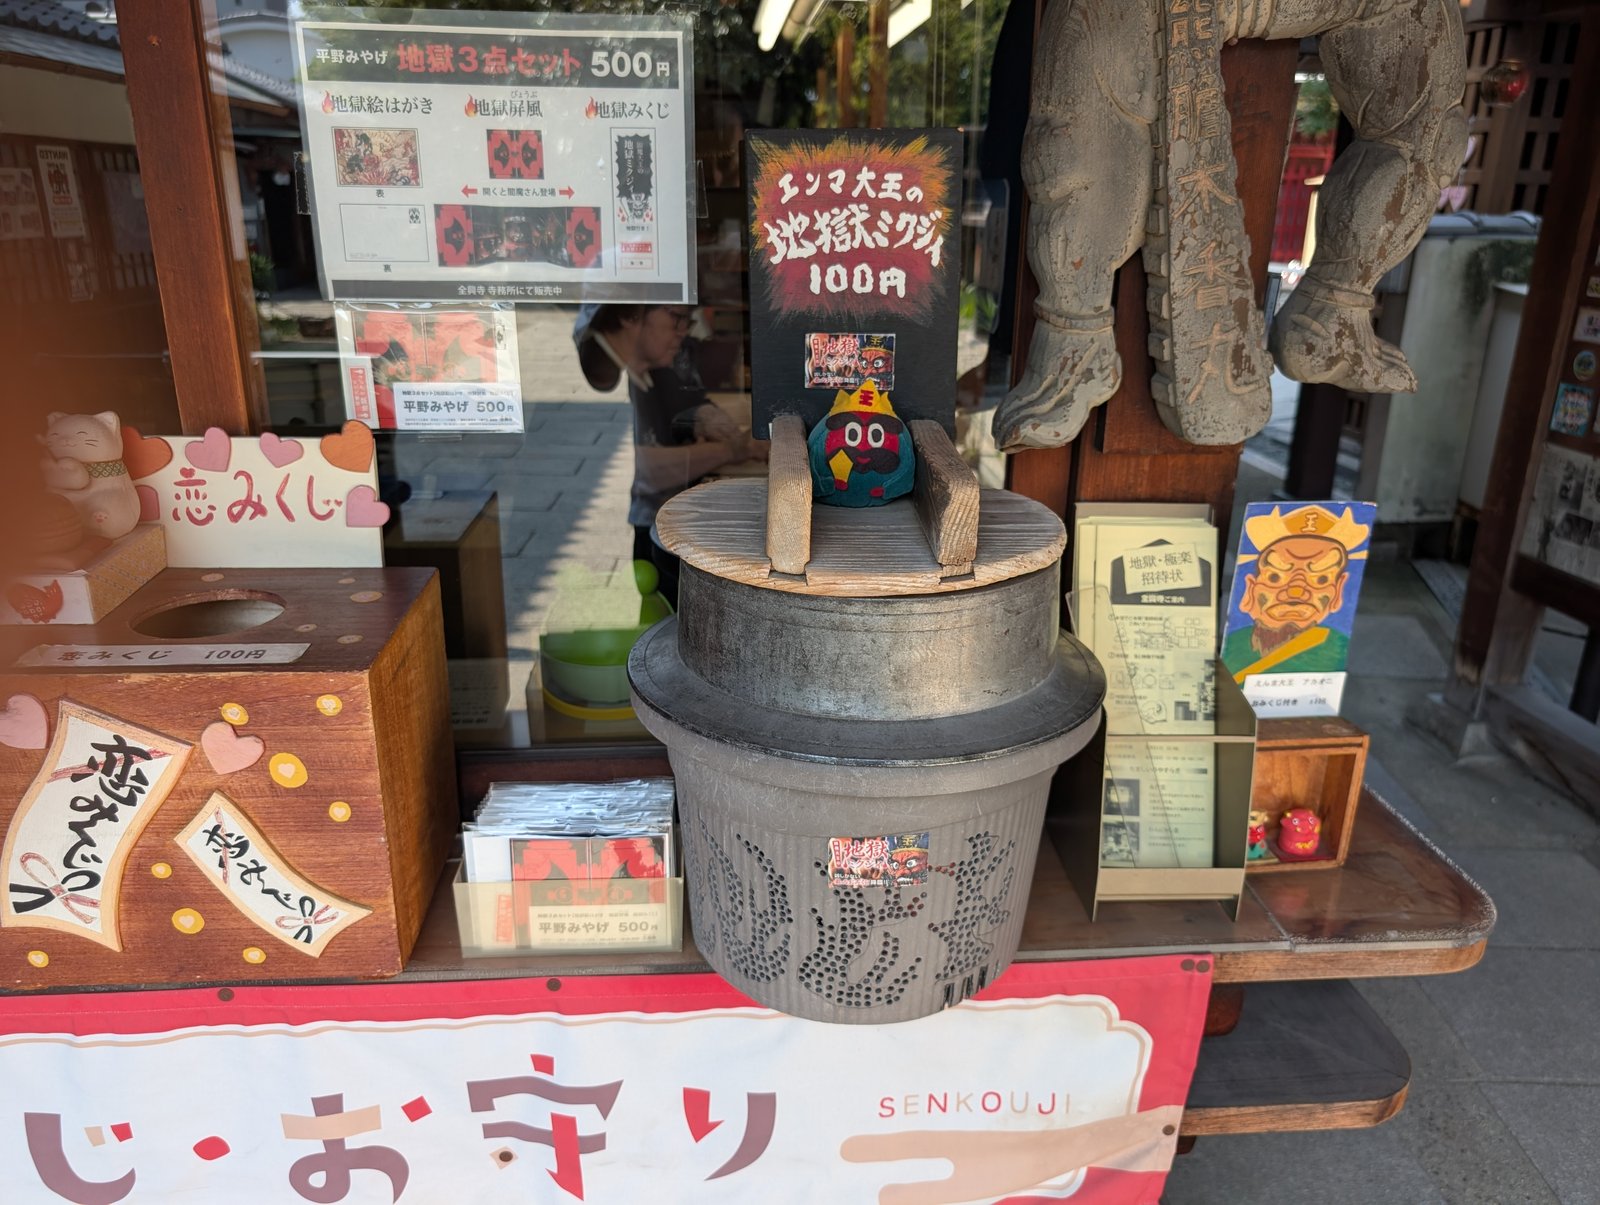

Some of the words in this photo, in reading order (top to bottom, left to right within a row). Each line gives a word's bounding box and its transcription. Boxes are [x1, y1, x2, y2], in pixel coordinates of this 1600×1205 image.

[316, 49, 388, 65] 平野みやげ
[397, 43, 582, 77] 地獄3点セット
[591, 51, 670, 78] 500円
[511, 90, 538, 98] びょうぶ
[331, 95, 433, 115] 地獄絵はがき
[474, 98, 543, 118] 地獄屏風
[595, 101, 669, 119] 地獄みくじ
[376, 189, 385, 198] 表
[482, 187, 556, 197] 開くと閻魔さん登場
[778, 166, 924, 204] エンマ大王の
[764, 203, 944, 267] 地獄ミクジィ
[809, 263, 906, 298] 100円
[488, 285, 562, 296] 寺務所にて販売中
[403, 400, 469, 413] 平野みやげ
[476, 401, 514, 413] 500円
[172, 468, 343, 526] 恋みくじ
[1128, 551, 1193, 571] 地獄・極楽
[1141, 570, 1184, 586] 招待状
[58, 648, 173, 662] 恋みくじ
[204, 648, 267, 661] 100円
[844, 840, 888, 859] 地獄
[538, 921, 610, 934] 平野みやげ
[618, 920, 658, 933] 500円
[878, 1091, 1071, 1118] SENKOUJI
